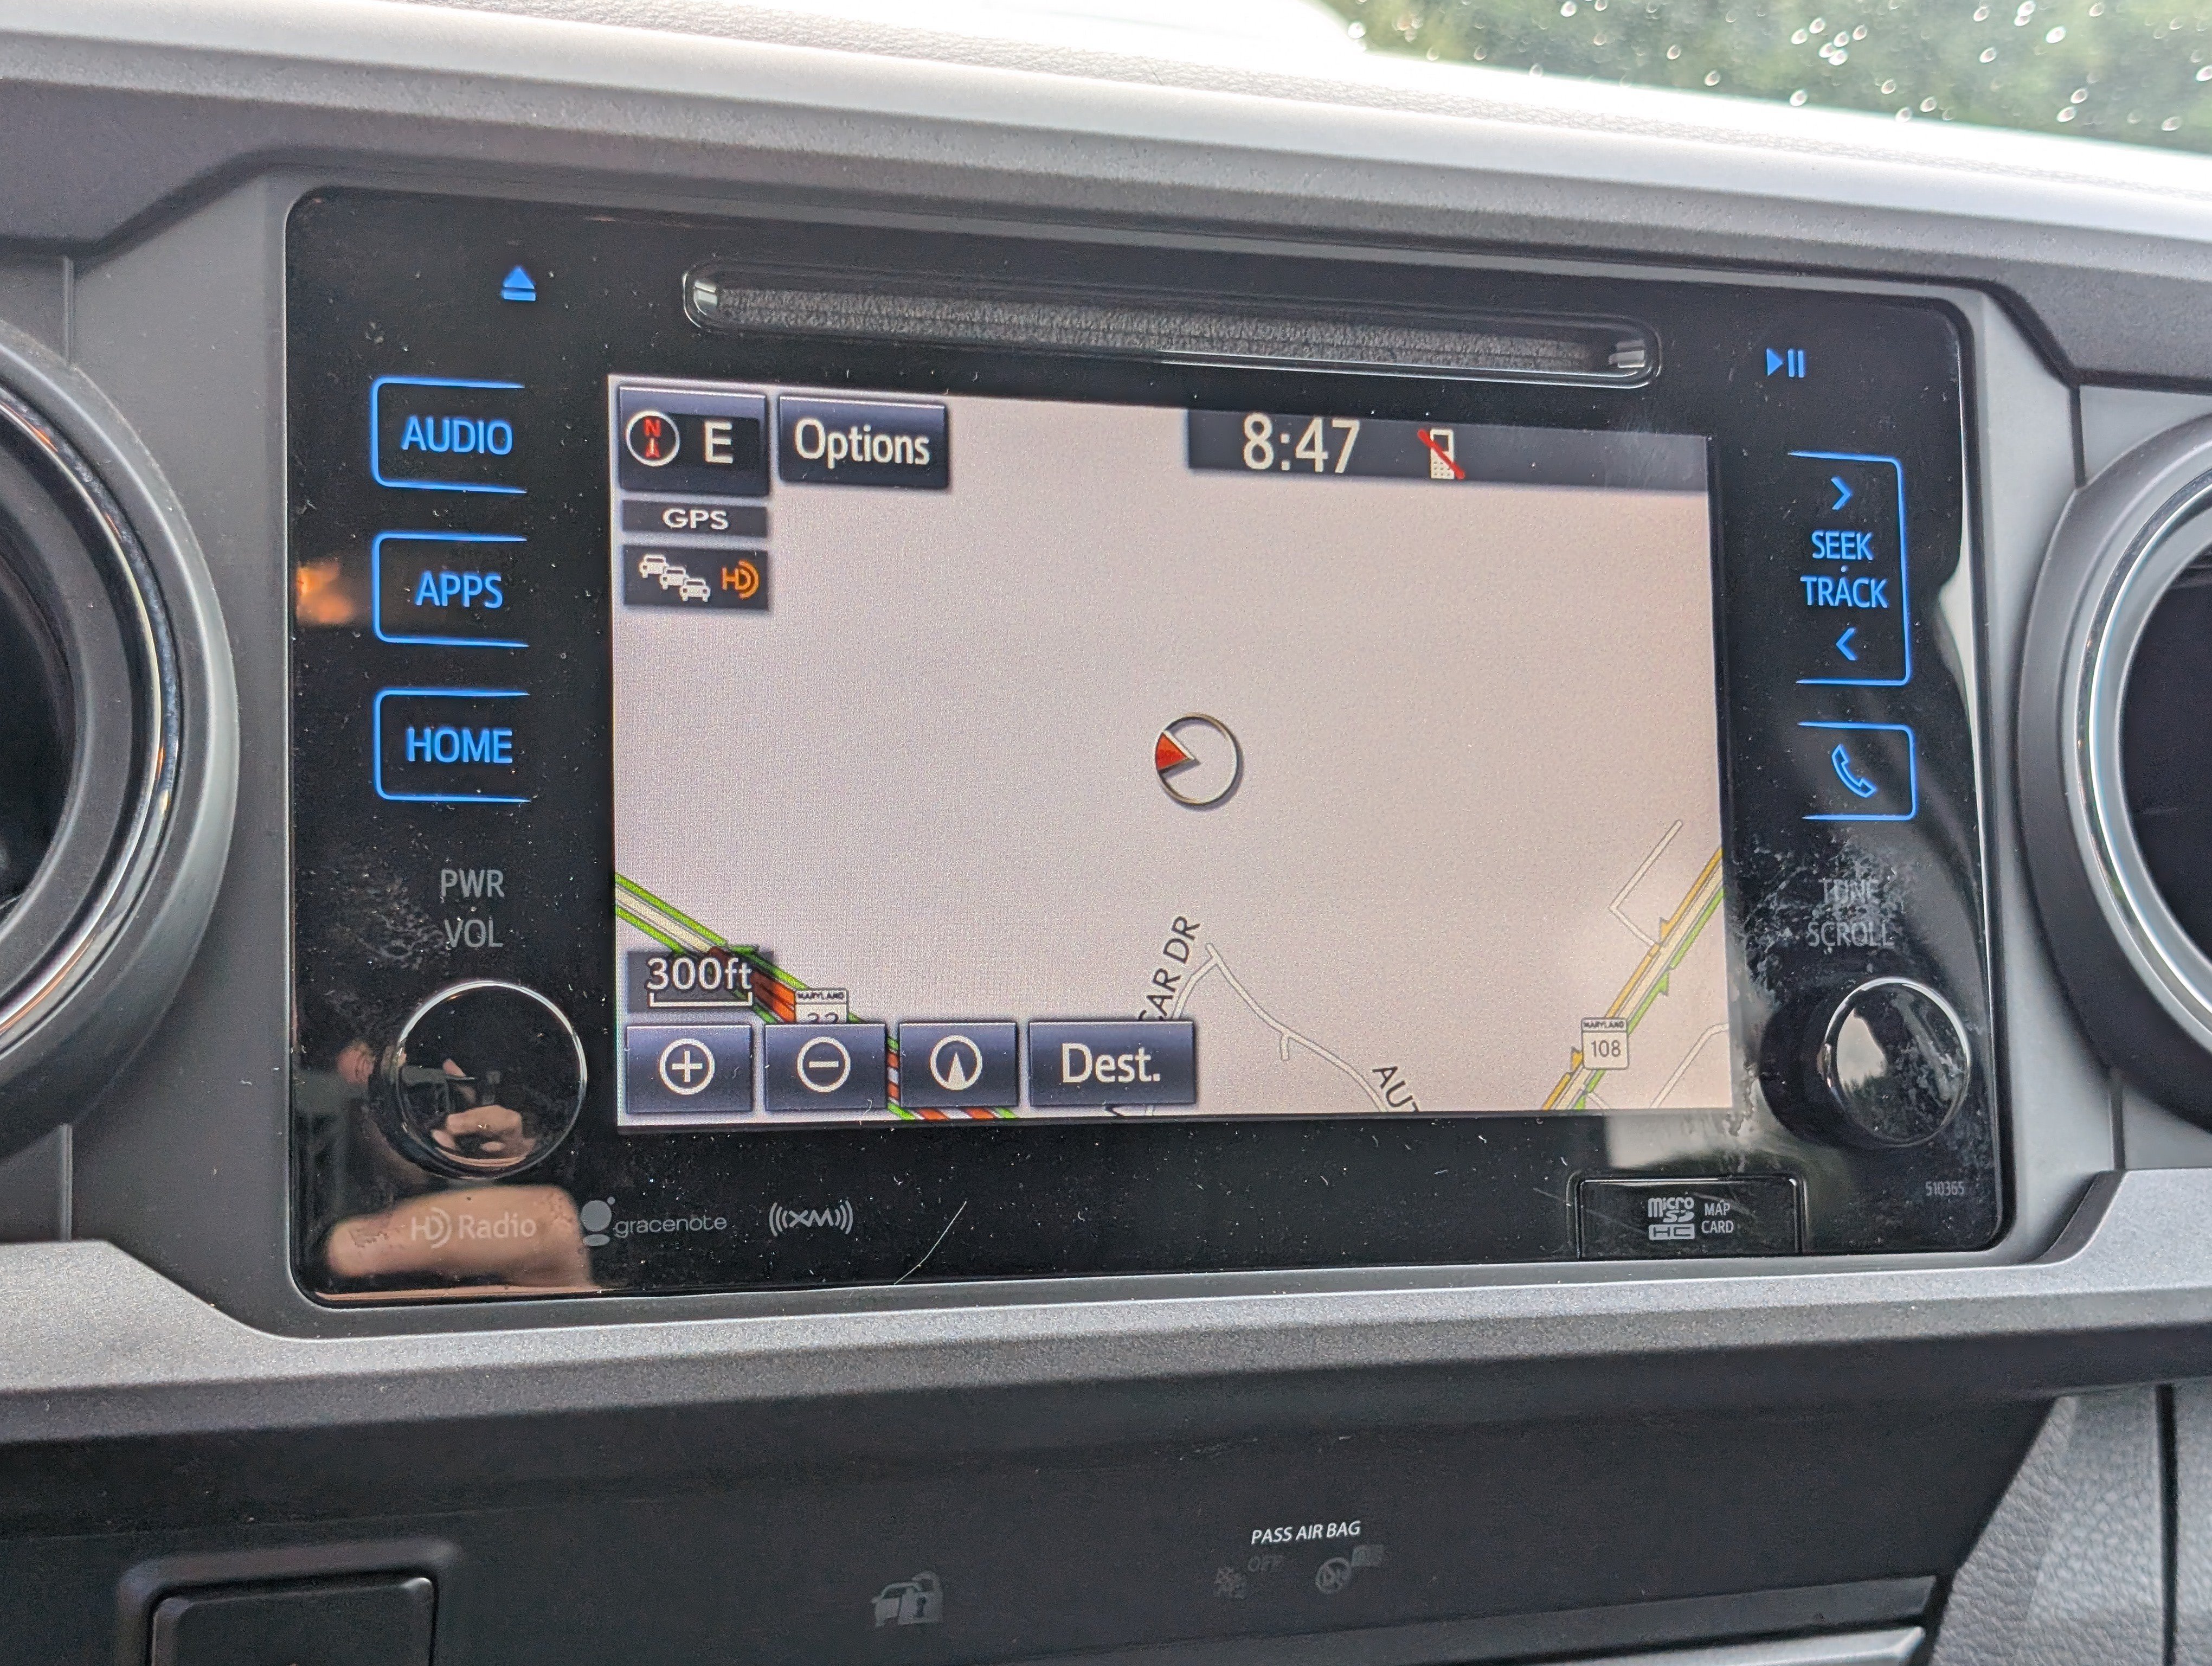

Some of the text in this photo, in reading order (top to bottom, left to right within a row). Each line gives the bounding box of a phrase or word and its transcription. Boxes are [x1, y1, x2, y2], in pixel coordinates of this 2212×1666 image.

[400, 414, 513, 455] AUDIO
[705, 421, 733, 464] E
[794, 417, 930, 469] Options
[1243, 412, 1360, 473] 8:47
[662, 508, 729, 530] GPS
[1811, 529, 1873, 560] SEEK
[415, 570, 503, 608] APPS
[1800, 575, 1889, 608] TRACK
[406, 726, 513, 764] HOME
[440, 869, 505, 898] PWR
[443, 918, 504, 948] VOL
[1163, 916, 1200, 964] DR
[1806, 920, 1895, 947] SCROLL
[647, 957, 752, 991] 300ft
[1061, 1042, 1161, 1084] Dest.
[1591, 1040, 1621, 1058] 108
[1648, 1196, 1695, 1218] micro
[1704, 1202, 1731, 1216] MAP
[459, 1211, 537, 1239] Radio
[615, 1214, 728, 1239] gracenote
[1701, 1220, 1734, 1234] CARD
[1250, 1520, 1361, 1545] PASS AIR BAG
